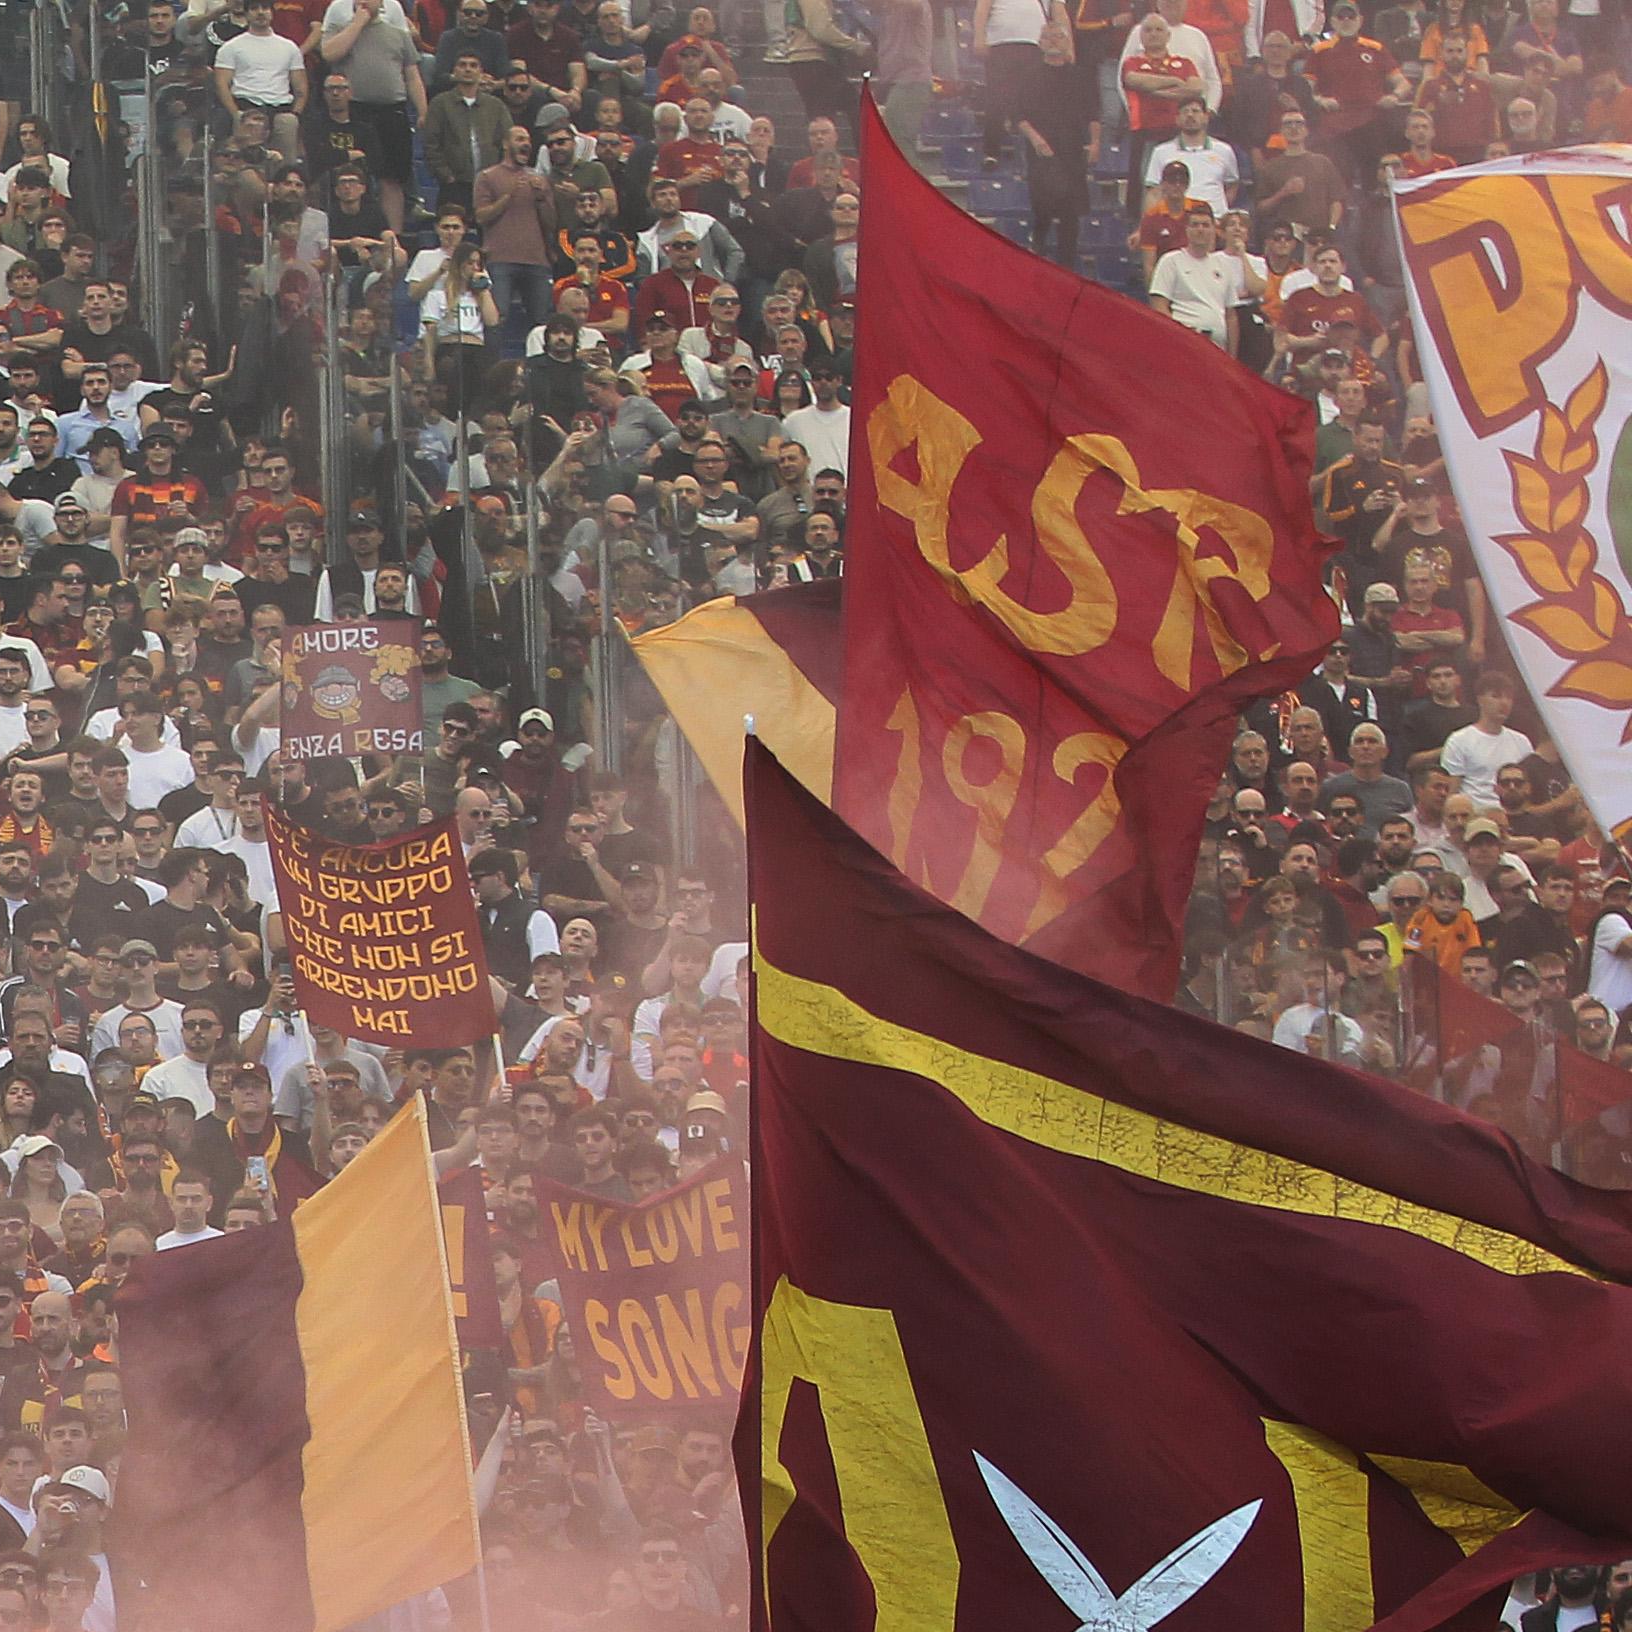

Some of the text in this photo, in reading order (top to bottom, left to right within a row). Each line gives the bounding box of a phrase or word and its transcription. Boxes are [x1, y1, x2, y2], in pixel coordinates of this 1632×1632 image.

[291, 626, 380, 655] AMORE
[282, 728, 424, 761] SENZA RESA
[300, 895, 436, 938] DI AMICI
[287, 914, 469, 973] CHE NON SI
[294, 953, 480, 1003] ARRENDONO
[351, 1005, 415, 1036] MAI
[548, 1178, 740, 1274] MY LOVE
[585, 1279, 751, 1404] SONG
